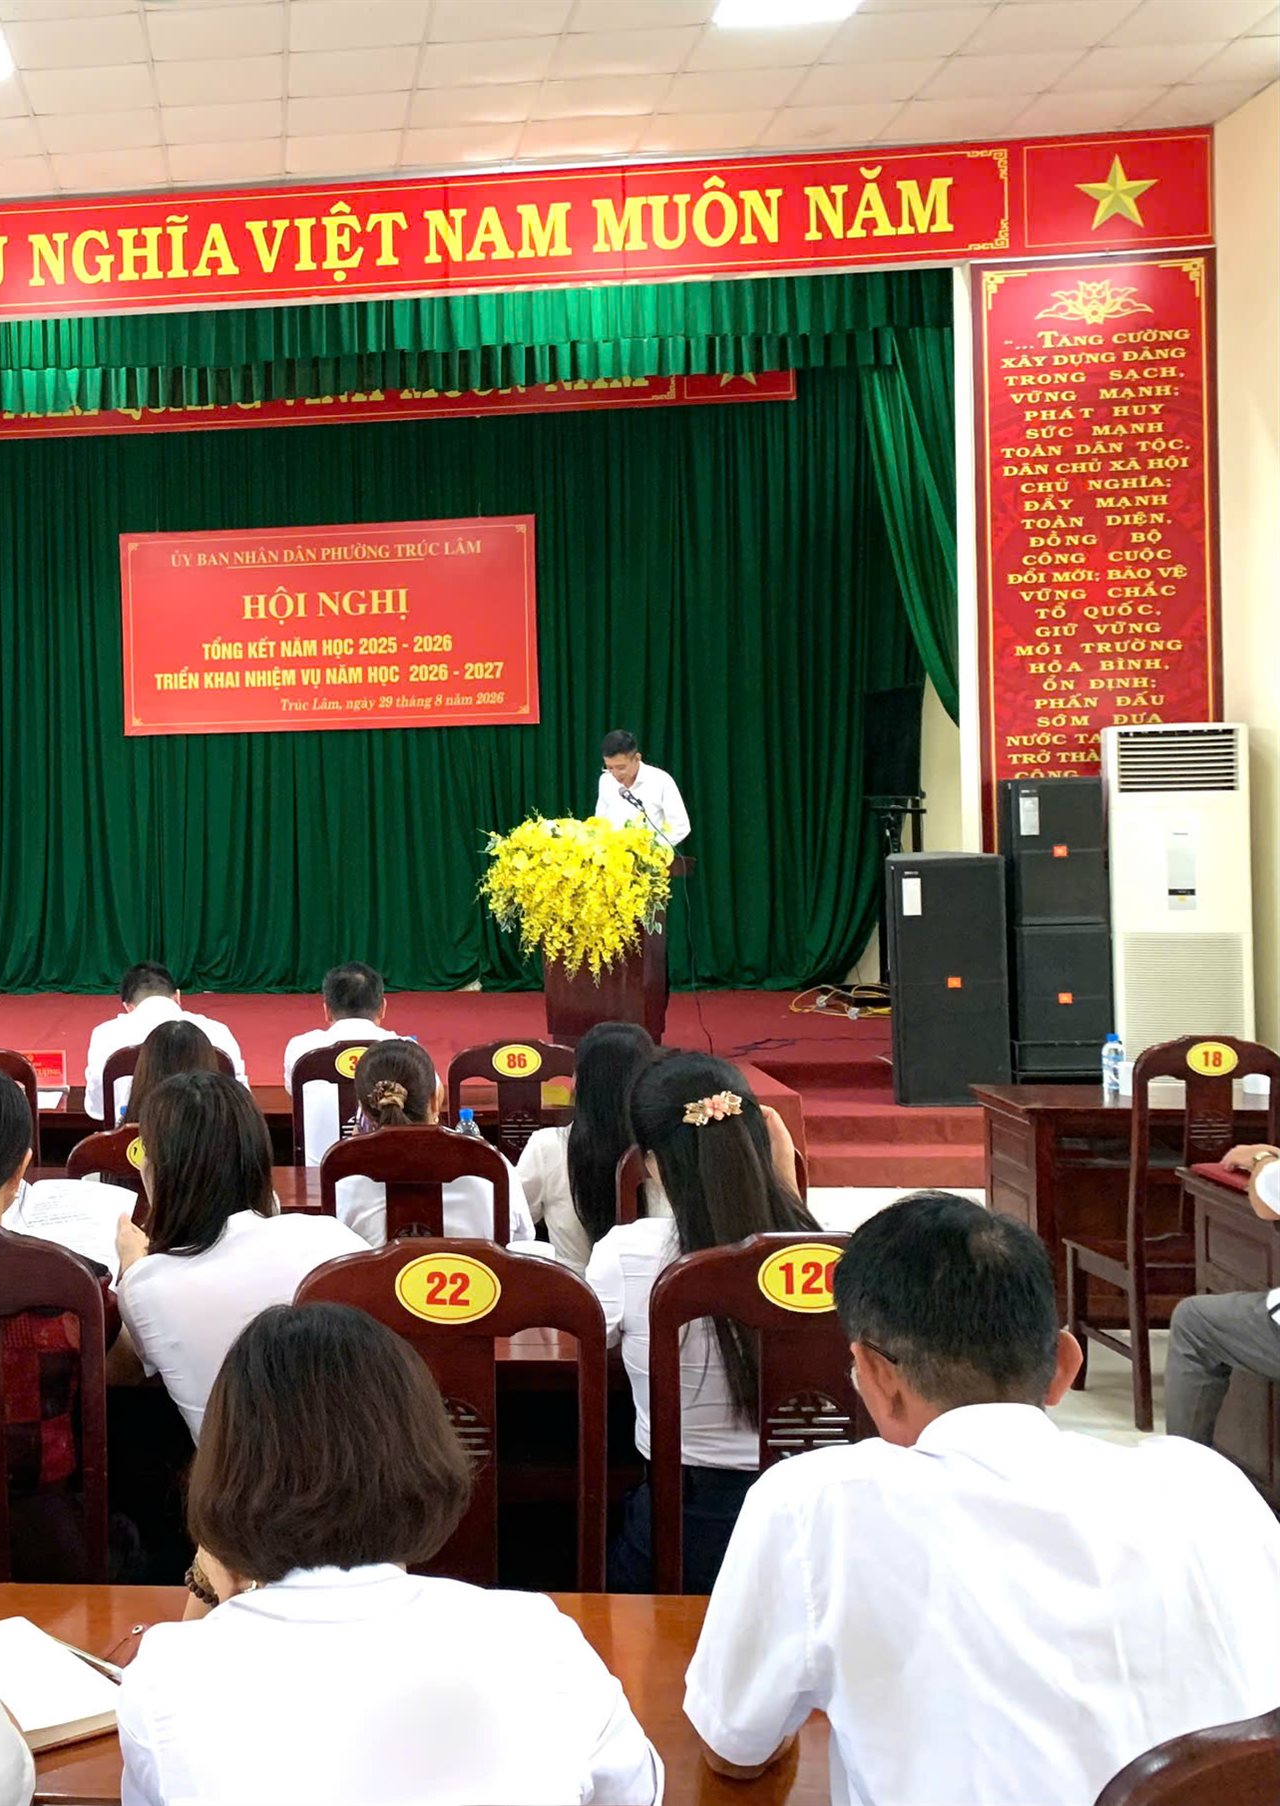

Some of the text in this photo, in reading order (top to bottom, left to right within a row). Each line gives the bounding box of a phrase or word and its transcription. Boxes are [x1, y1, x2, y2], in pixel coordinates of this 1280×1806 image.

[28, 214, 239, 287] NGHĨA
[245, 201, 408, 282] VIỆT
[424, 202, 572, 264] NAM
[592, 175, 782, 253] MUÔN
[804, 165, 954, 241] NĂM
[1112, 329, 1191, 344] CƯỜNG
[1001, 346, 1186, 368] XÂY DỰNG ĐẢNG
[1004, 372, 1086, 386] TRONG
[1010, 390, 1077, 404] VỮNG
[1025, 404, 1165, 421] PHÁT HUY
[1025, 422, 1164, 439] SỨC MẠNH
[1001, 444, 1063, 458] TOÀN
[1075, 441, 1123, 455] DÂN
[1003, 455, 1189, 476] DÂN CHỦ XÃ HỘI
[1021, 478, 1069, 493] CHỦ
[1024, 494, 1168, 512] ĐẨY MẠNH
[1021, 515, 1084, 529] TOÀN
[1029, 529, 1162, 547] ĐỒNG BỘ
[171, 539, 481, 567] ỦY BAN NHÂN DÂN PHƯỜNG TRÚC LÂM
[1022, 547, 1172, 566] CÔNG CUỘC
[1007, 568, 1046, 584] ĐỔI
[1107, 566, 1151, 580] BẢO
[1157, 564, 1187, 579] VỆ
[1020, 581, 1176, 602] VỮNG CHẮC
[243, 586, 407, 625] HỘI NGHỊ
[1035, 602, 1066, 619] TỔ
[1035, 621, 1162, 637] GIỮ VỮNG
[202, 636, 243, 660] TỔNG
[248, 636, 276, 659] KẾT
[280, 637, 317, 657] NĂM
[322, 638, 354, 659] HỌC
[359, 637, 397, 655] 2025
[413, 634, 452, 653] 2026
[1015, 638, 1183, 656] MÔI TRƯỜNG
[154, 666, 199, 690] TRIỂN
[204, 671, 240, 689] KHAI
[245, 666, 296, 690] NHIỆM
[301, 668, 320, 689] VỤ
[326, 664, 362, 684] NĂM
[368, 666, 399, 687] HỌC
[409, 664, 448, 682] 2026
[464, 662, 503, 680] 2027
[280, 692, 504, 711] Trúc Lâm, ngày 29 tháng 8 năm 2026
[1034, 691, 1165, 709] PHẤN ĐẤU
[1037, 714, 1163, 728] SỚM ĐƯA
[1006, 732, 1067, 746] NƯỚC
[1008, 749, 1051, 764] TRỞ
[506, 1053, 527, 1070] 86
[1202, 1050, 1222, 1067] 18
[426, 1271, 470, 1306] 22
